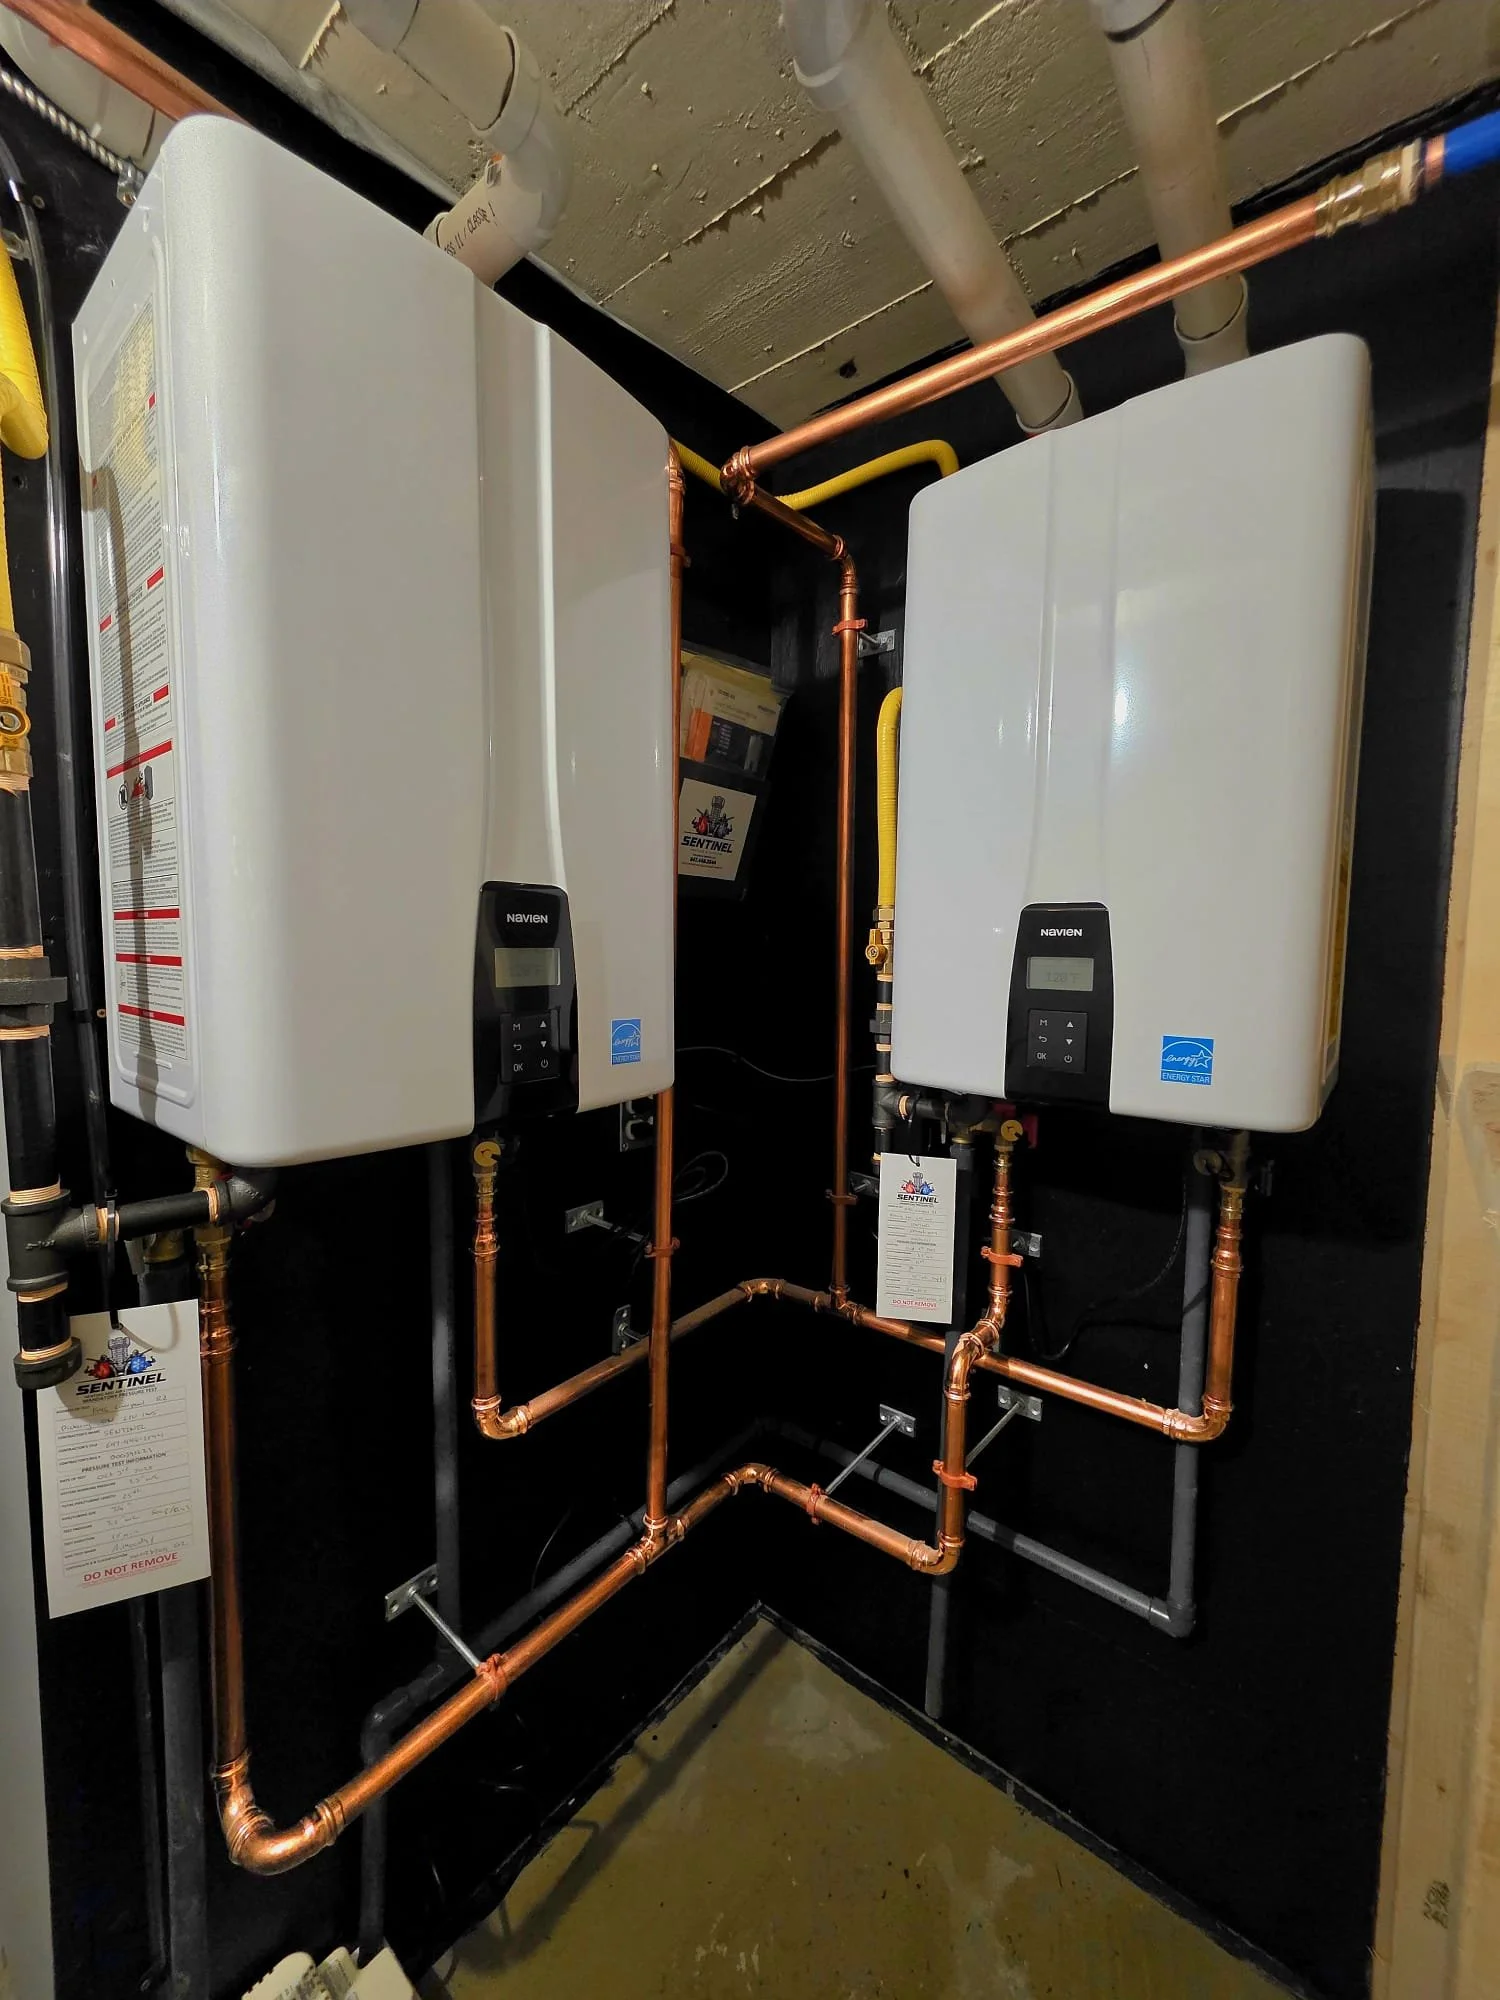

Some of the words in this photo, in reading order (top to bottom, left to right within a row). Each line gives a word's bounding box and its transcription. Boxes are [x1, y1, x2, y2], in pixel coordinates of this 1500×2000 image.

[681, 836, 733, 853] SENTINEL
[1039, 1019, 1048, 1027] M
[1037, 1052, 1047, 1060] OK
[513, 1063, 523, 1073] OK
[1162, 1072, 1191, 1082] ENERGY
[1191, 1075, 1210, 1084] STAR
[897, 1193, 939, 1204] SENTINEL
[76, 1373, 167, 1396] SENTINEL
[83, 1571, 101, 1582] DO
[104, 1564, 128, 1577] NOT
[131, 1551, 178, 1570] REMOVE
